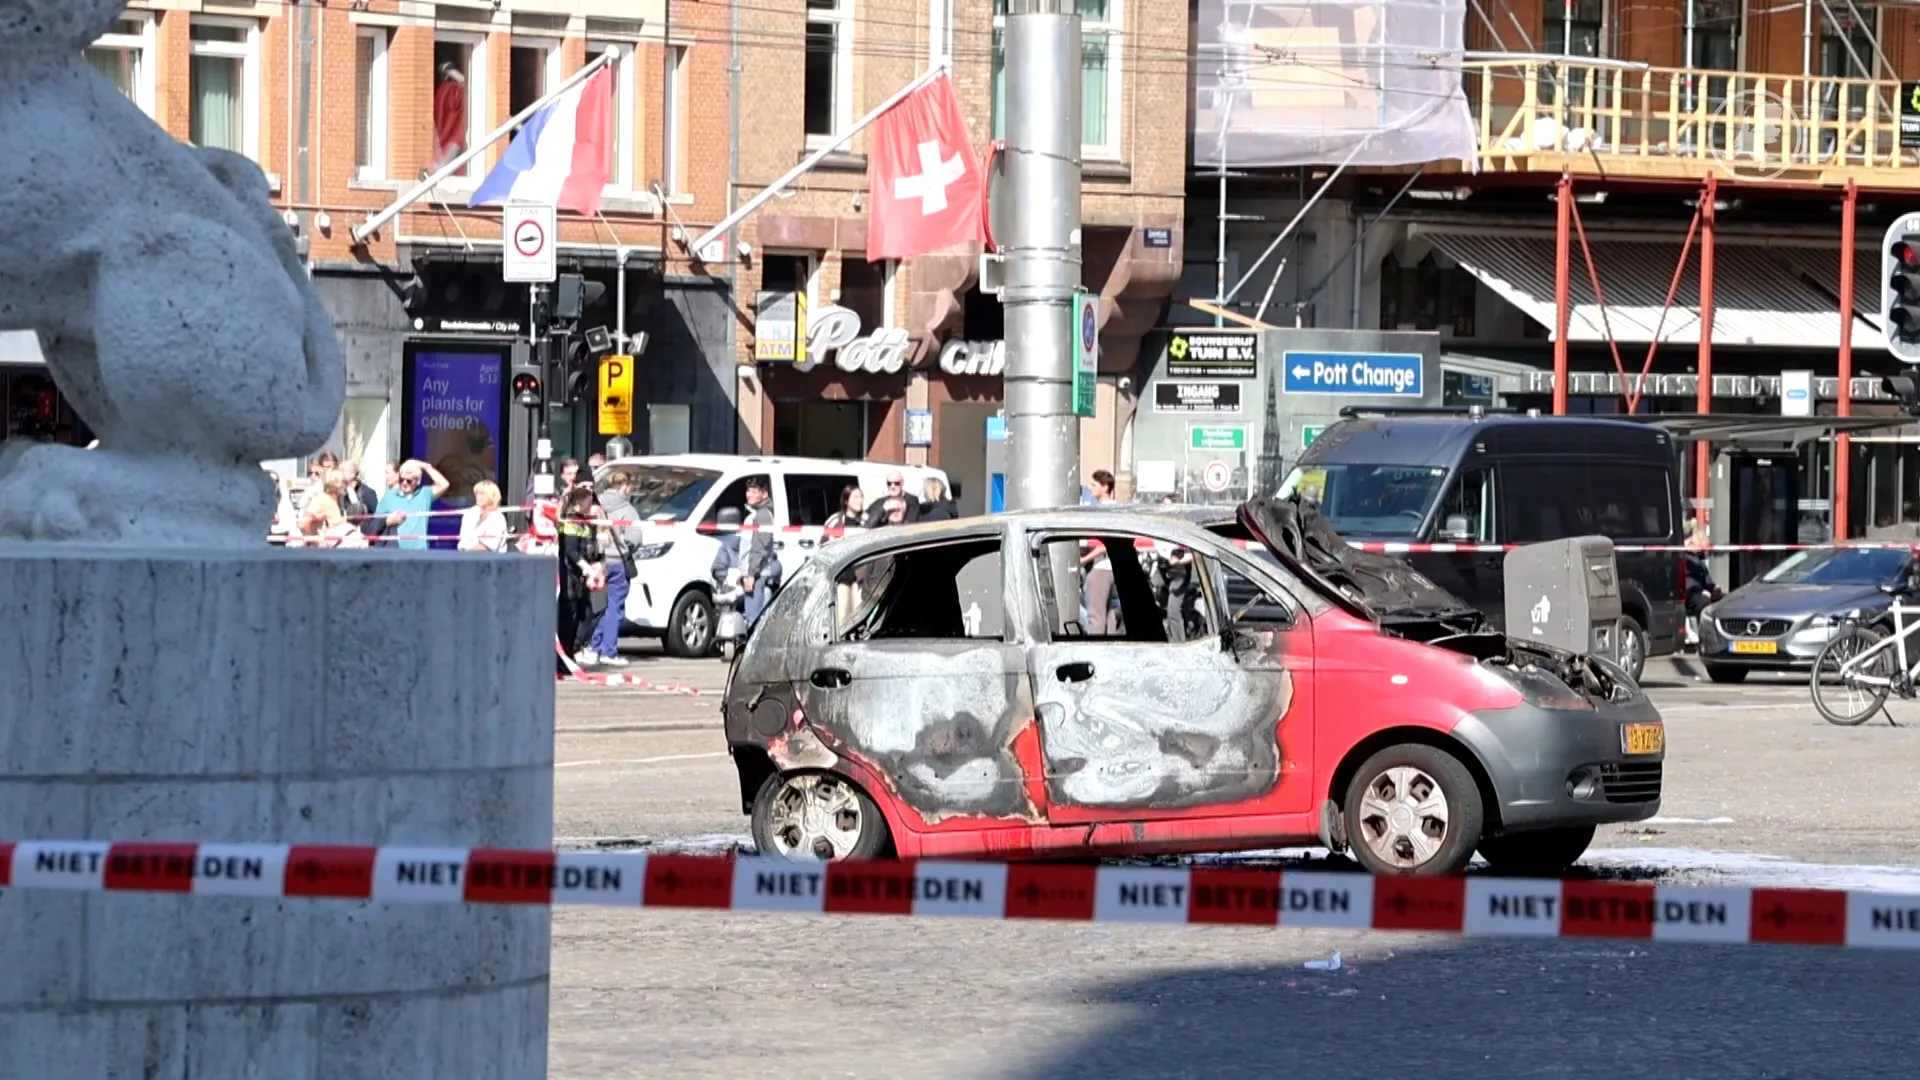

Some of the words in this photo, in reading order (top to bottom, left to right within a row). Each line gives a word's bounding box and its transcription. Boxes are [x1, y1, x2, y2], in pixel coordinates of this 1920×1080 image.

[803, 305, 909, 372] Pott
[1189, 337, 1254, 346] BOUWBEDRIJF
[759, 343, 792, 357] ATM
[1189, 347, 1224, 359] TUIN
[1226, 347, 1255, 359] B.V.
[479, 363, 499, 374] April
[608, 362, 623, 388] P
[1313, 361, 1350, 386] Pott
[1352, 363, 1415, 392] Change
[422, 376, 450, 395] Any
[1177, 385, 1219, 398] INGANG
[421, 396, 464, 413] plants
[465, 396, 485, 412] for
[421, 413, 473, 431] coffee?
[35, 848, 100, 875] NIET
[111, 853, 263, 880] BETREDEN
[396, 859, 463, 887] NIET
[471, 862, 622, 891] BETREDEN
[755, 870, 821, 896] NIET
[829, 872, 983, 902] BETREDEN
[1119, 881, 1186, 908] NIET
[1195, 883, 1350, 913] BETREDEN
[1490, 893, 1556, 920] NIET
[1565, 897, 1728, 926] BETREDEN
